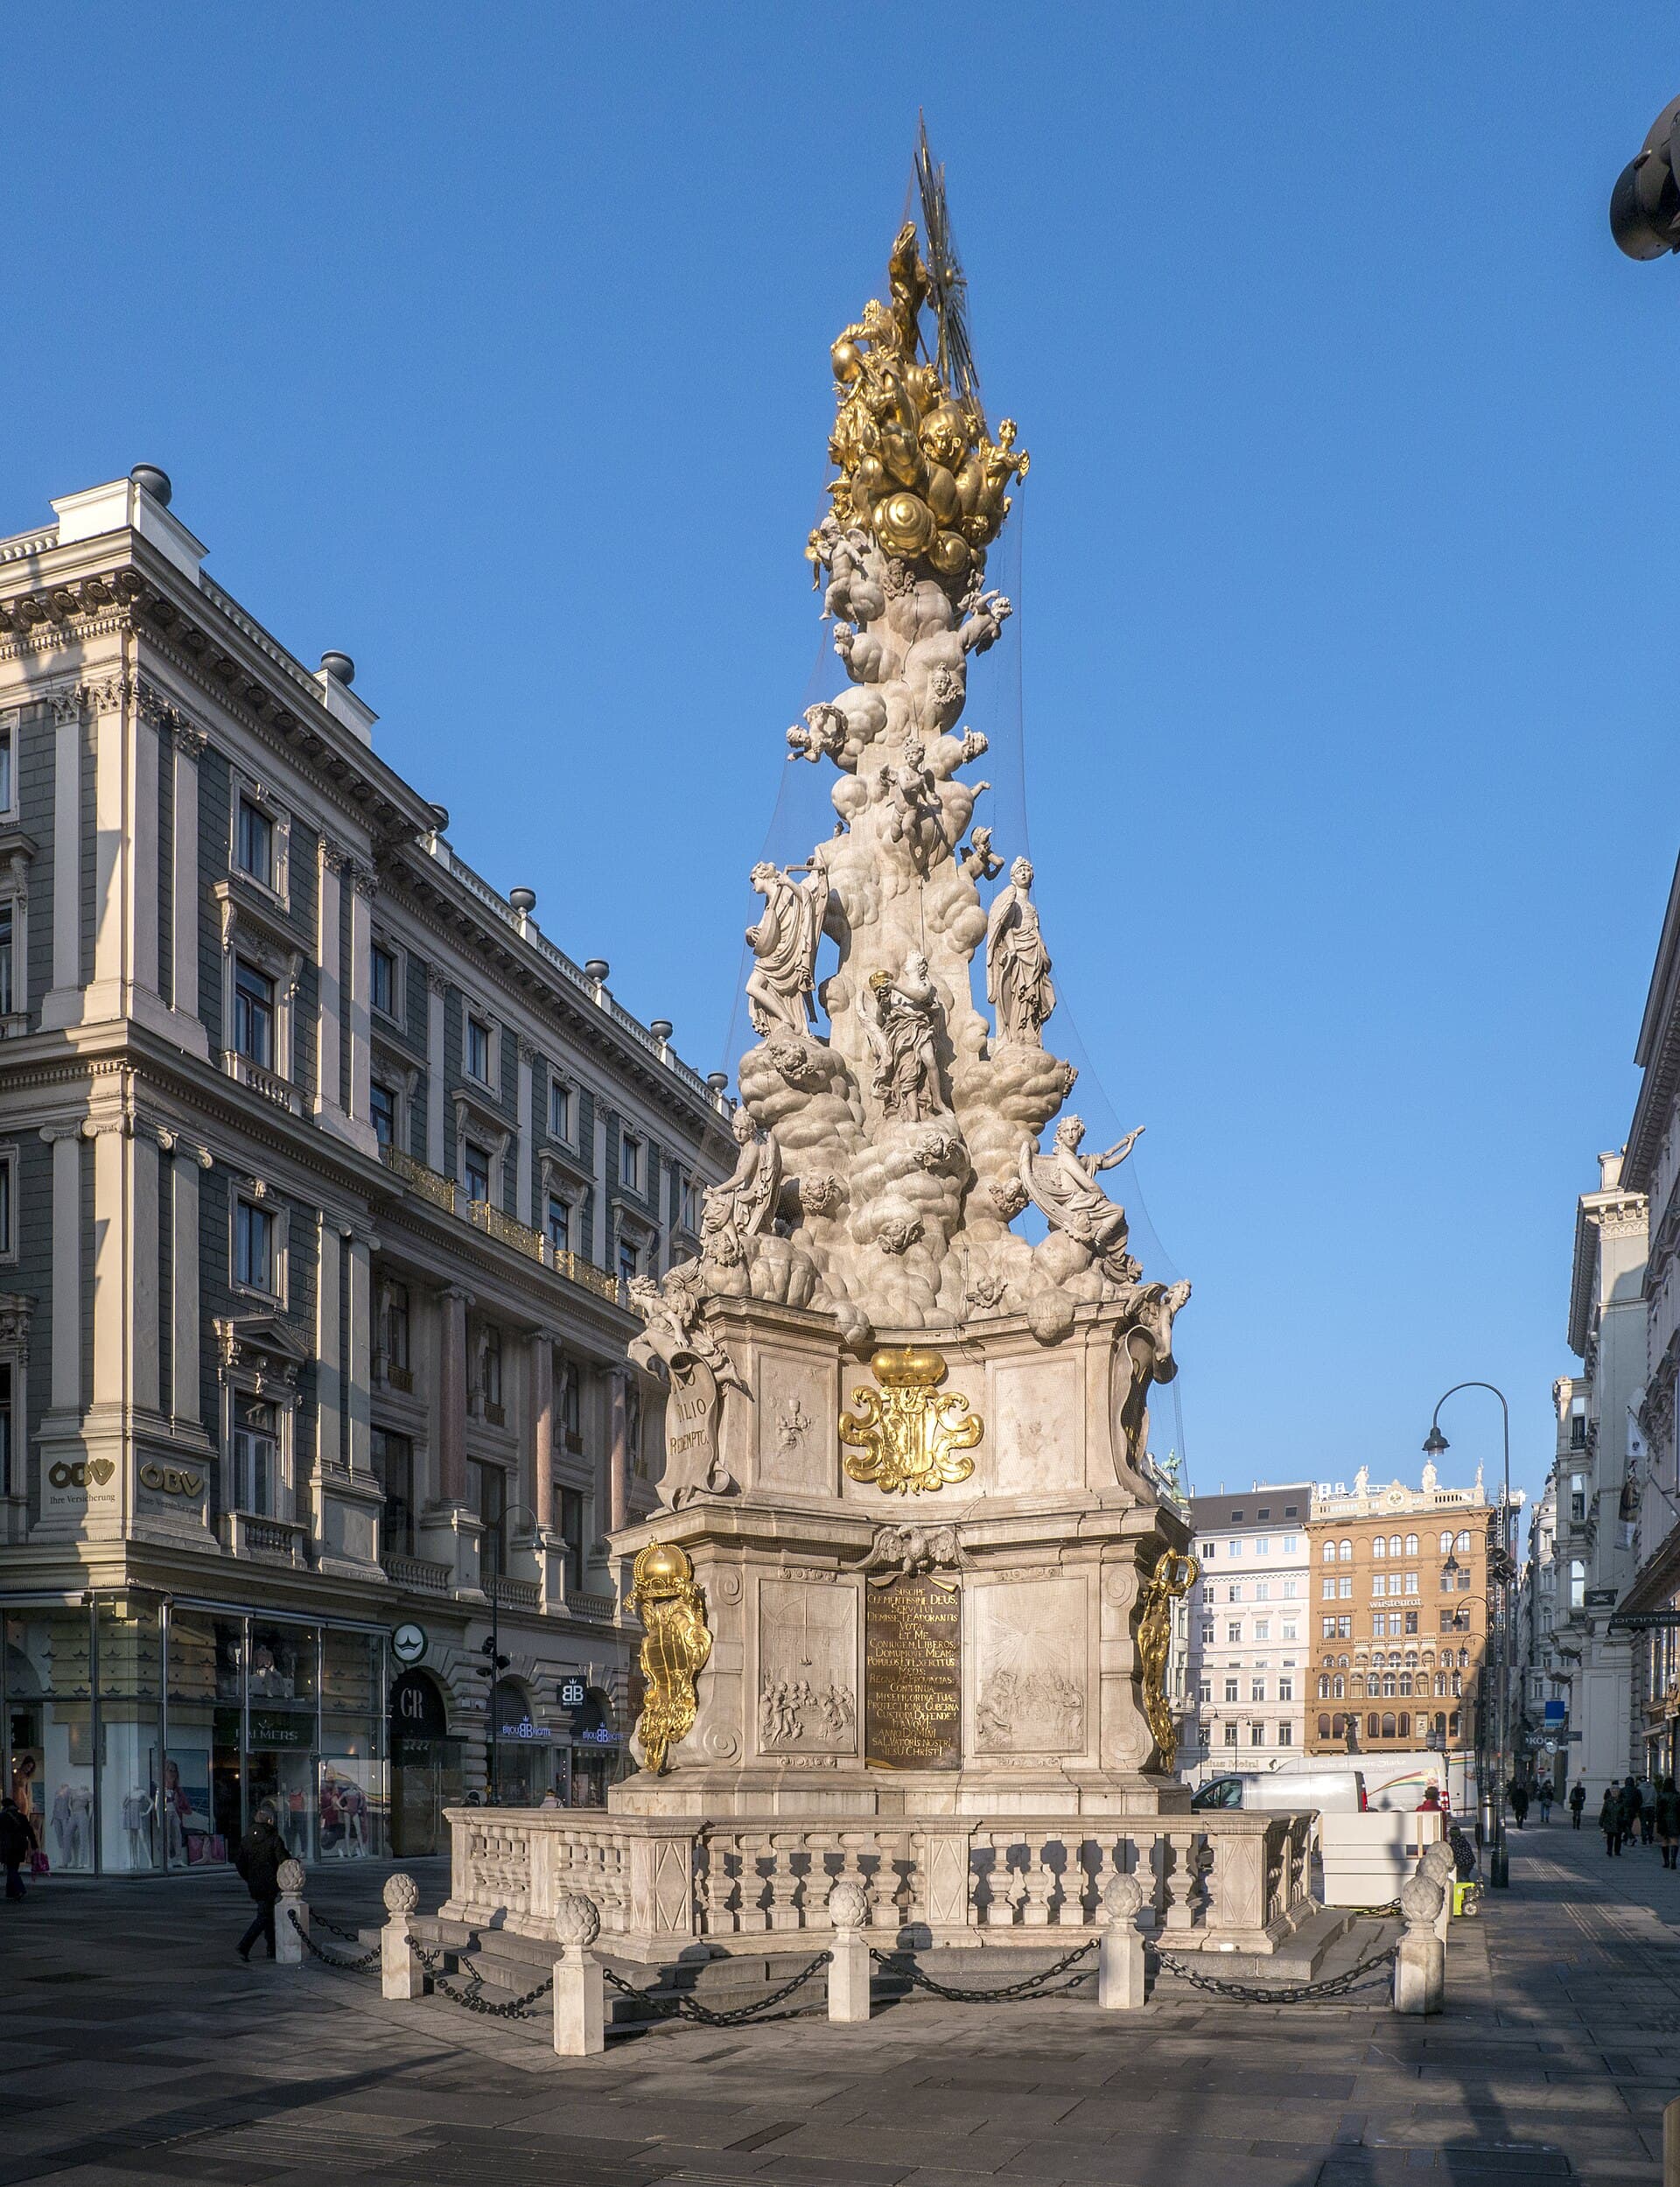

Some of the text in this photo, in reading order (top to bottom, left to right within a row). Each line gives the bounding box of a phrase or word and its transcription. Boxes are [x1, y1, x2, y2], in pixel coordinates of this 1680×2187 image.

[49, 1494, 116, 1504] Ihre Versicherung
[930, 1594, 958, 1605] DEUS,
[902, 1727, 936, 1738] DOMINI
